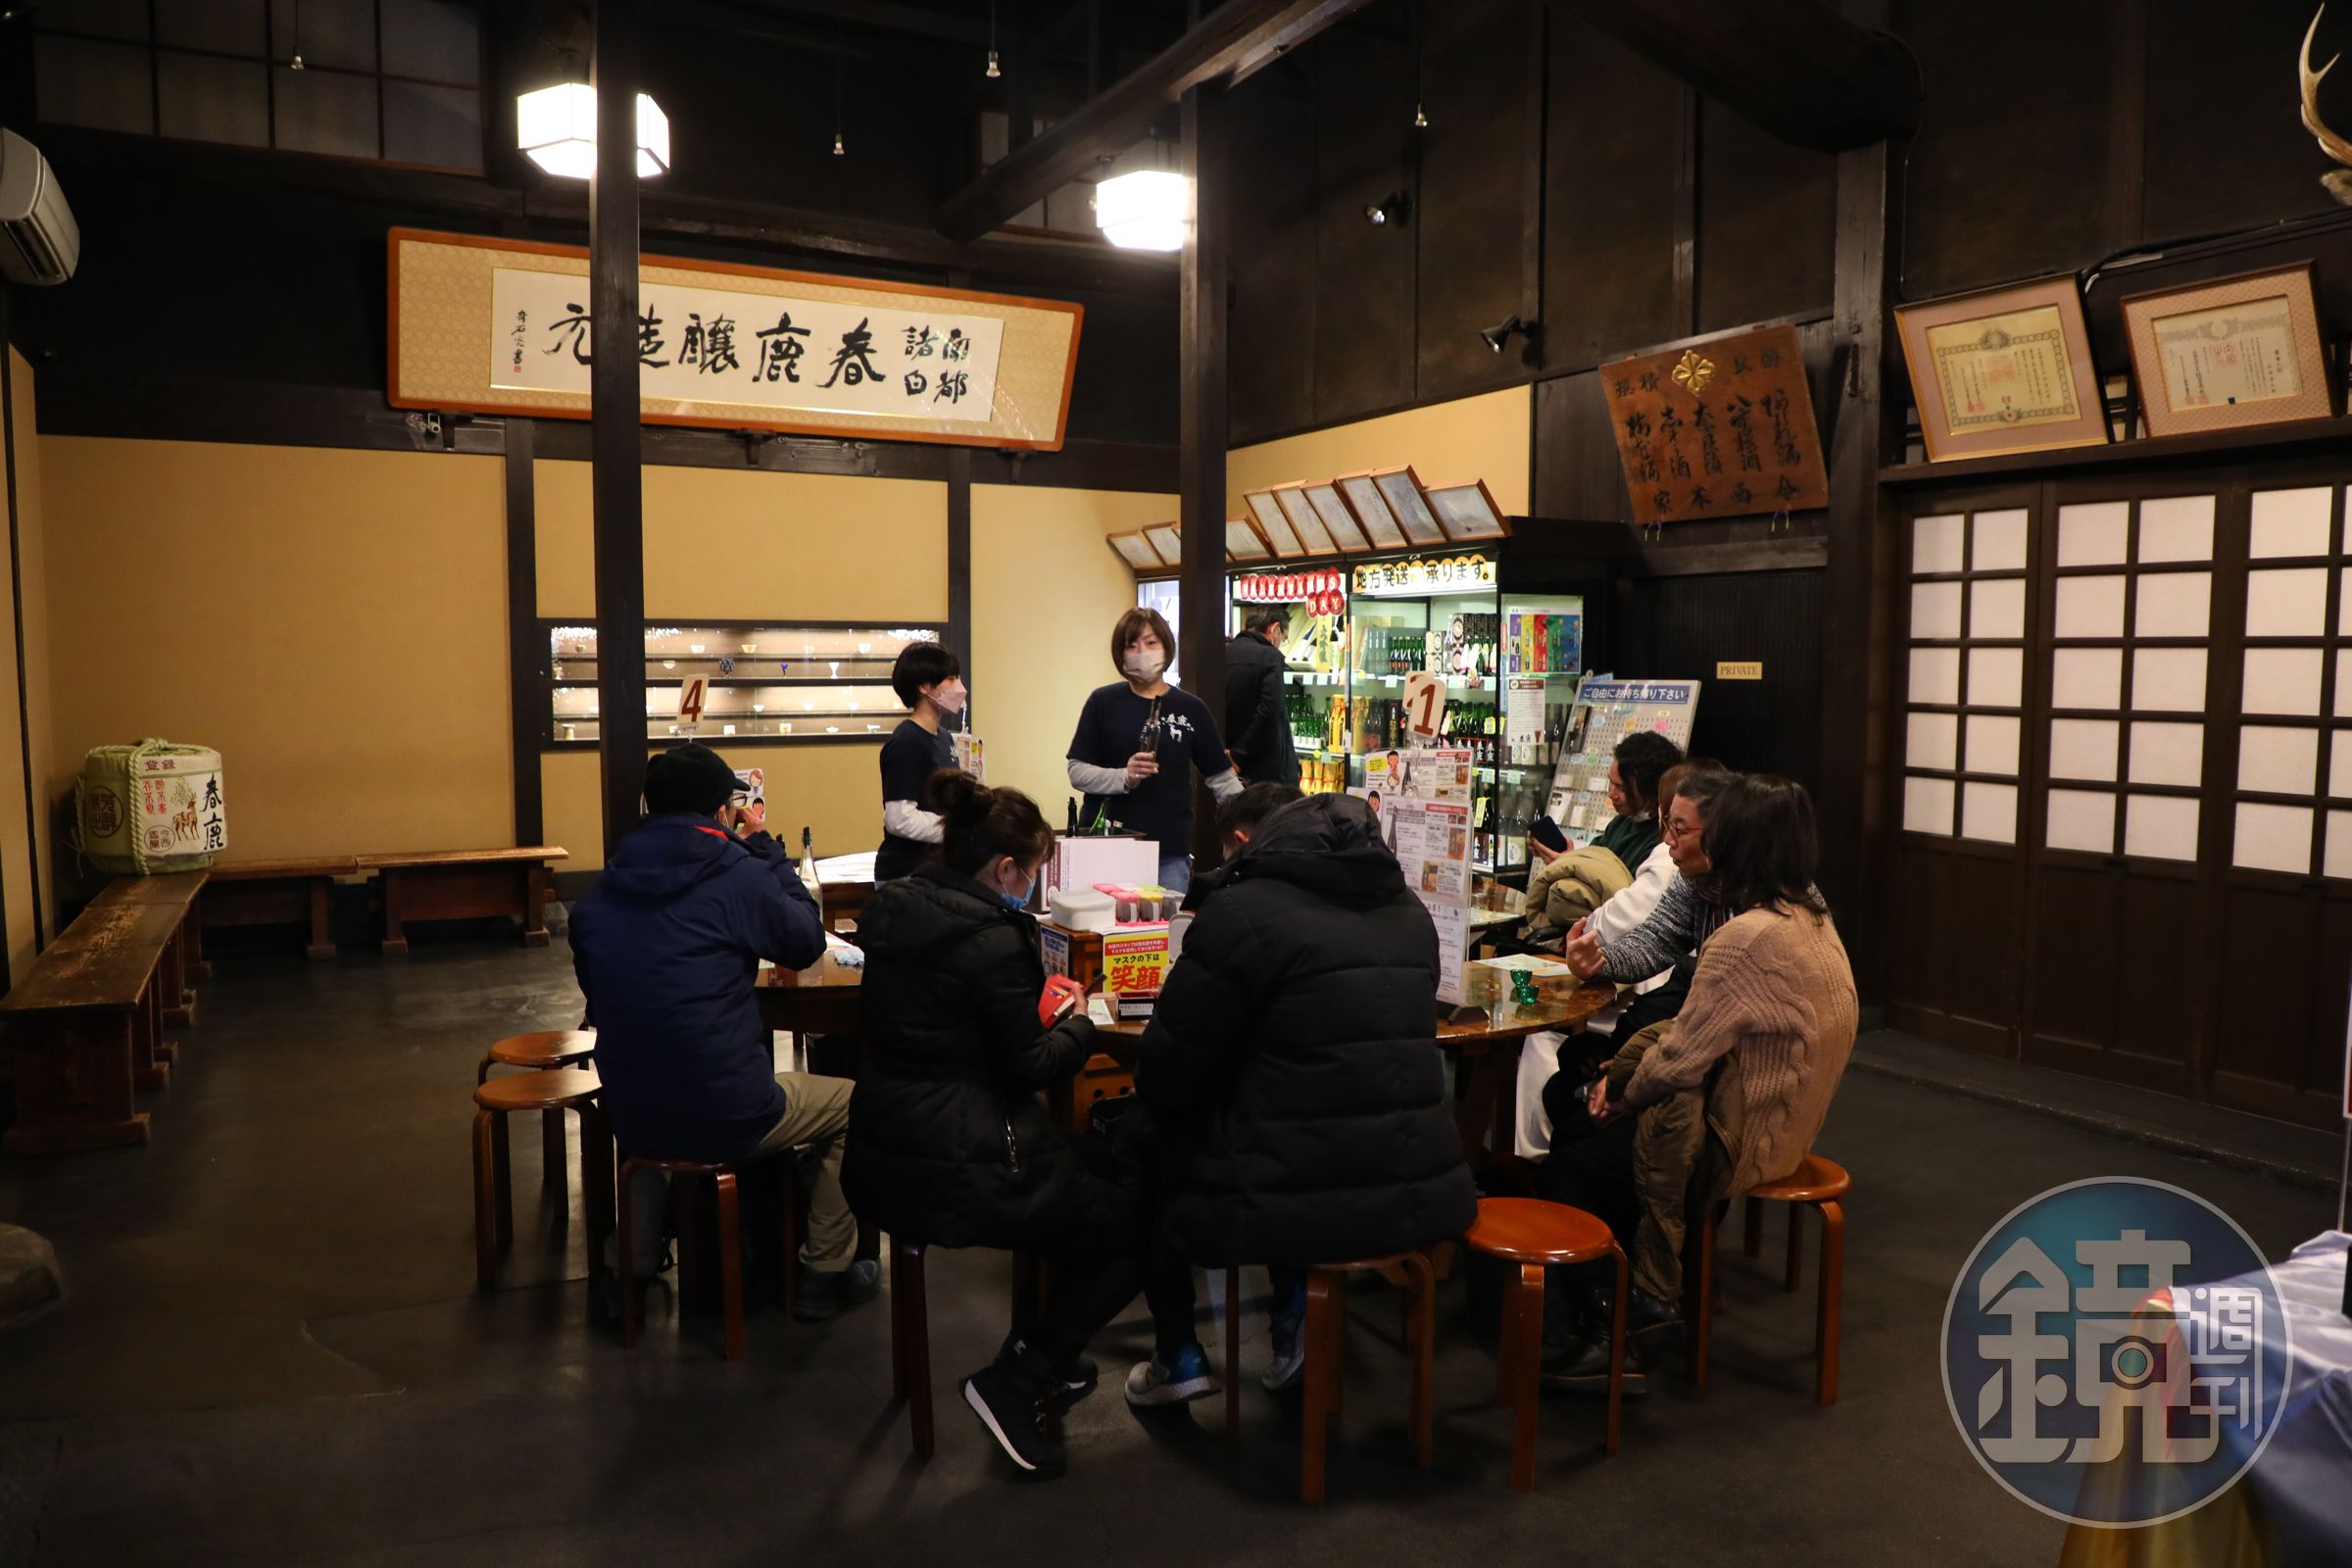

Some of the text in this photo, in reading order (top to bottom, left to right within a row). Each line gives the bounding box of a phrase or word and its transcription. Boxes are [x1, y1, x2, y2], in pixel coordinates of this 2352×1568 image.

[1356, 564, 1408, 589] 地方発送
[1309, 597, 1340, 612] DAY
[1720, 665, 1758, 675] PRIVATE
[681, 679, 703, 722] 4
[1584, 688, 1685, 701] ご自由にお持ち帰り下さい
[1414, 684, 1436, 735] 1
[200, 772, 223, 851] 春鹿
[1113, 954, 1159, 964] マスクの下は
[1111, 964, 1160, 992] 笑顔
